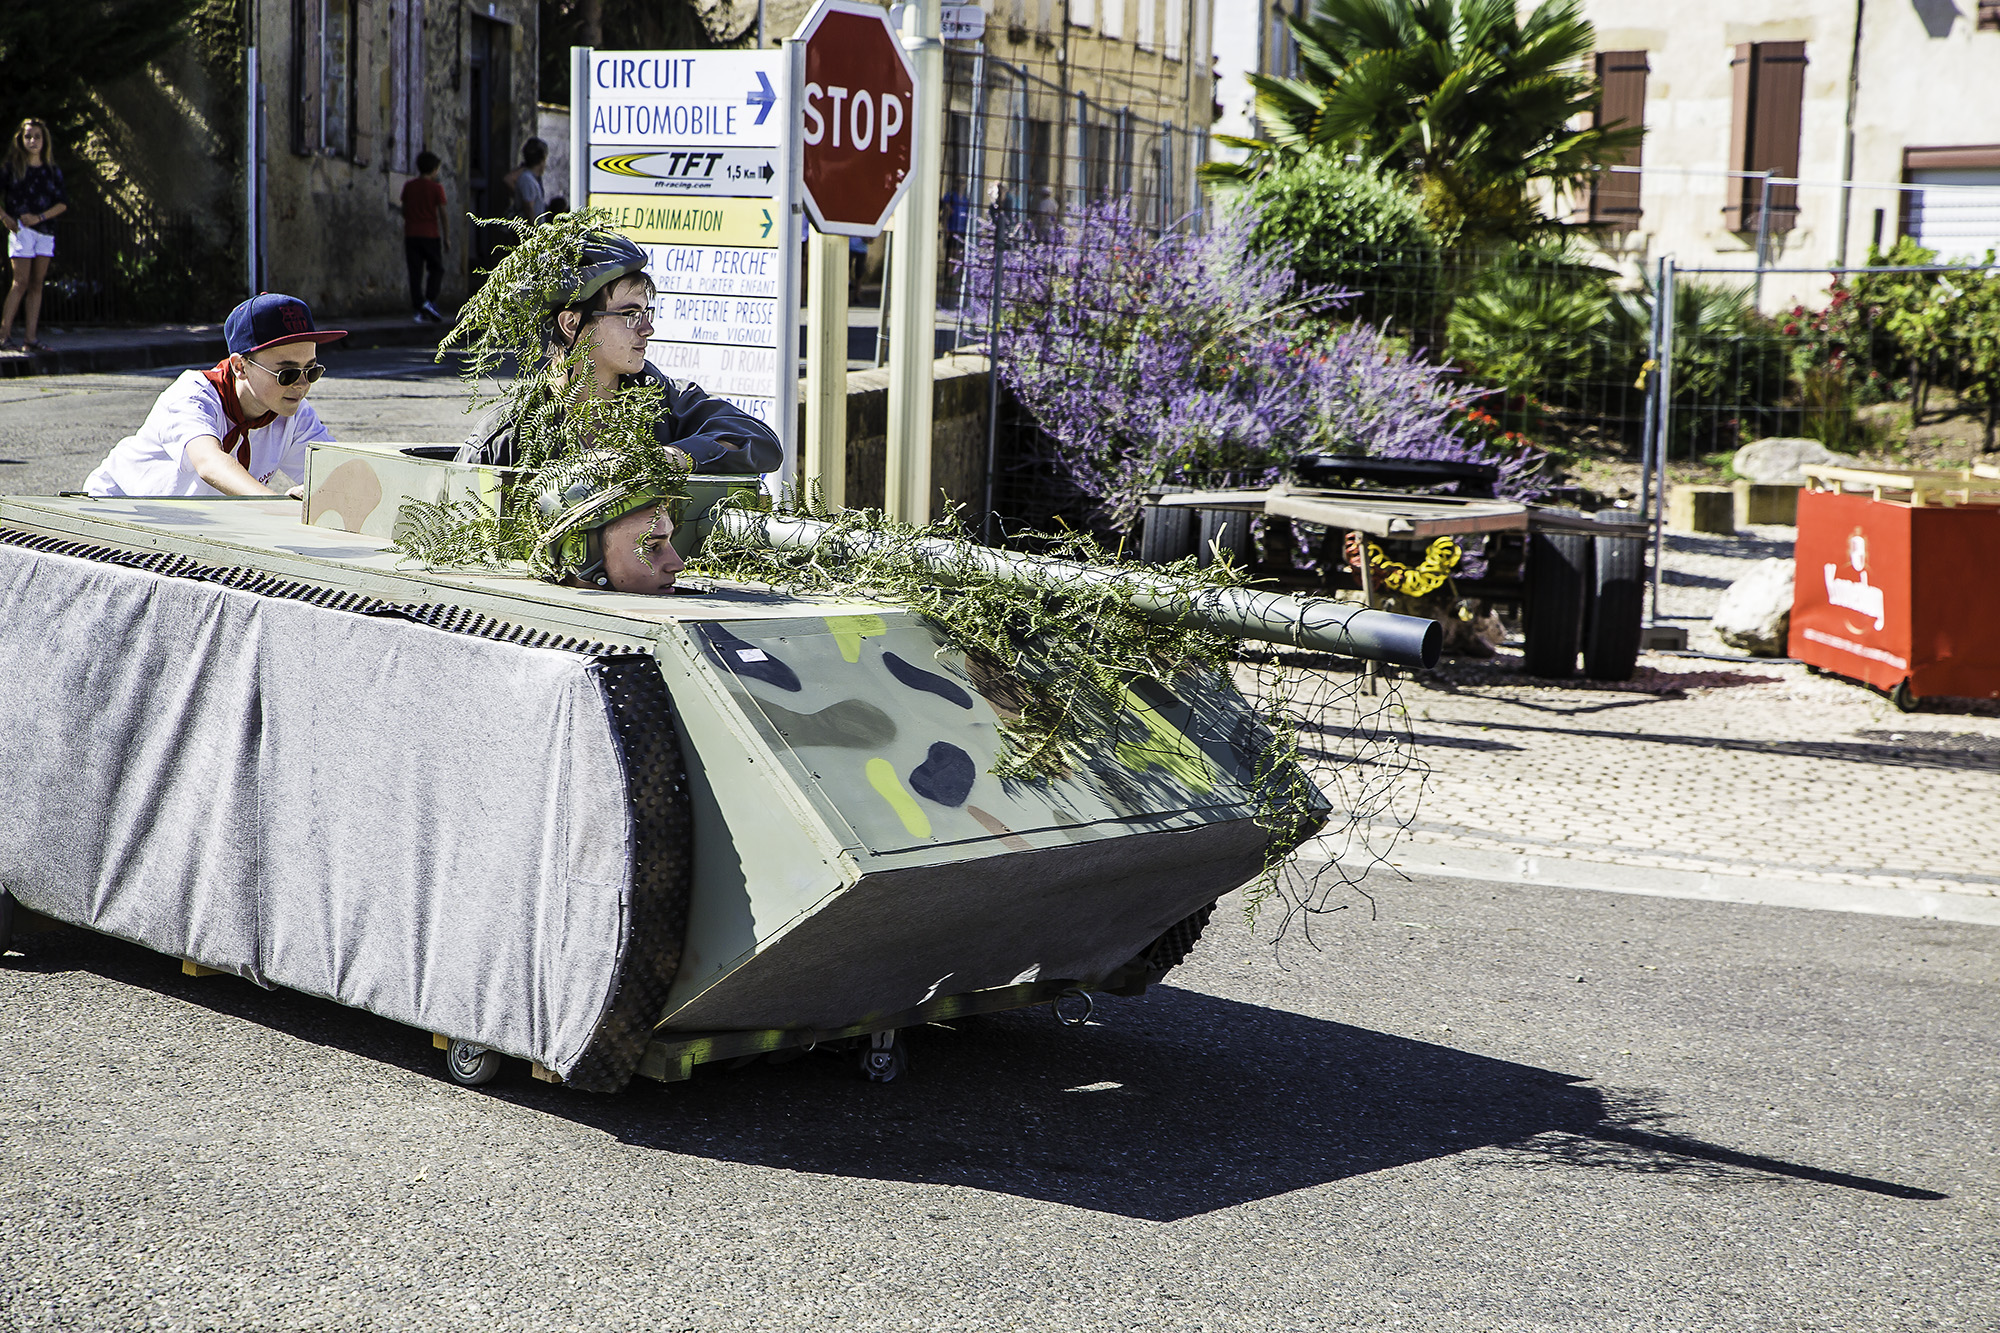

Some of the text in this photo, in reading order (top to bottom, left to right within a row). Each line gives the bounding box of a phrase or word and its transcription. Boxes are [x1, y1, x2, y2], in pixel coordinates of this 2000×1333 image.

[597, 59, 695, 88] CIRCUIT
[593, 105, 737, 135] AUTOMOBILE
[803, 82, 904, 153] STOP
[668, 152, 724, 177] TFT
[727, 165, 741, 181] 1,5
[654, 181, 712, 189] tft-racing.com
[635, 207, 724, 232] D'ANIMATION
[666, 248, 704, 273] CHAT
[712, 251, 776, 275] PERCHE"
[658, 275, 776, 295] PRET A PORTER ENFANT
[674, 298, 729, 323] PAPETERIE
[735, 302, 774, 325] PRESSE
[691, 326, 772, 345] Mme VIGNOLI
[647, 344, 775, 374] PIZZERIA DI ROMA
[715, 377, 723, 390] A
